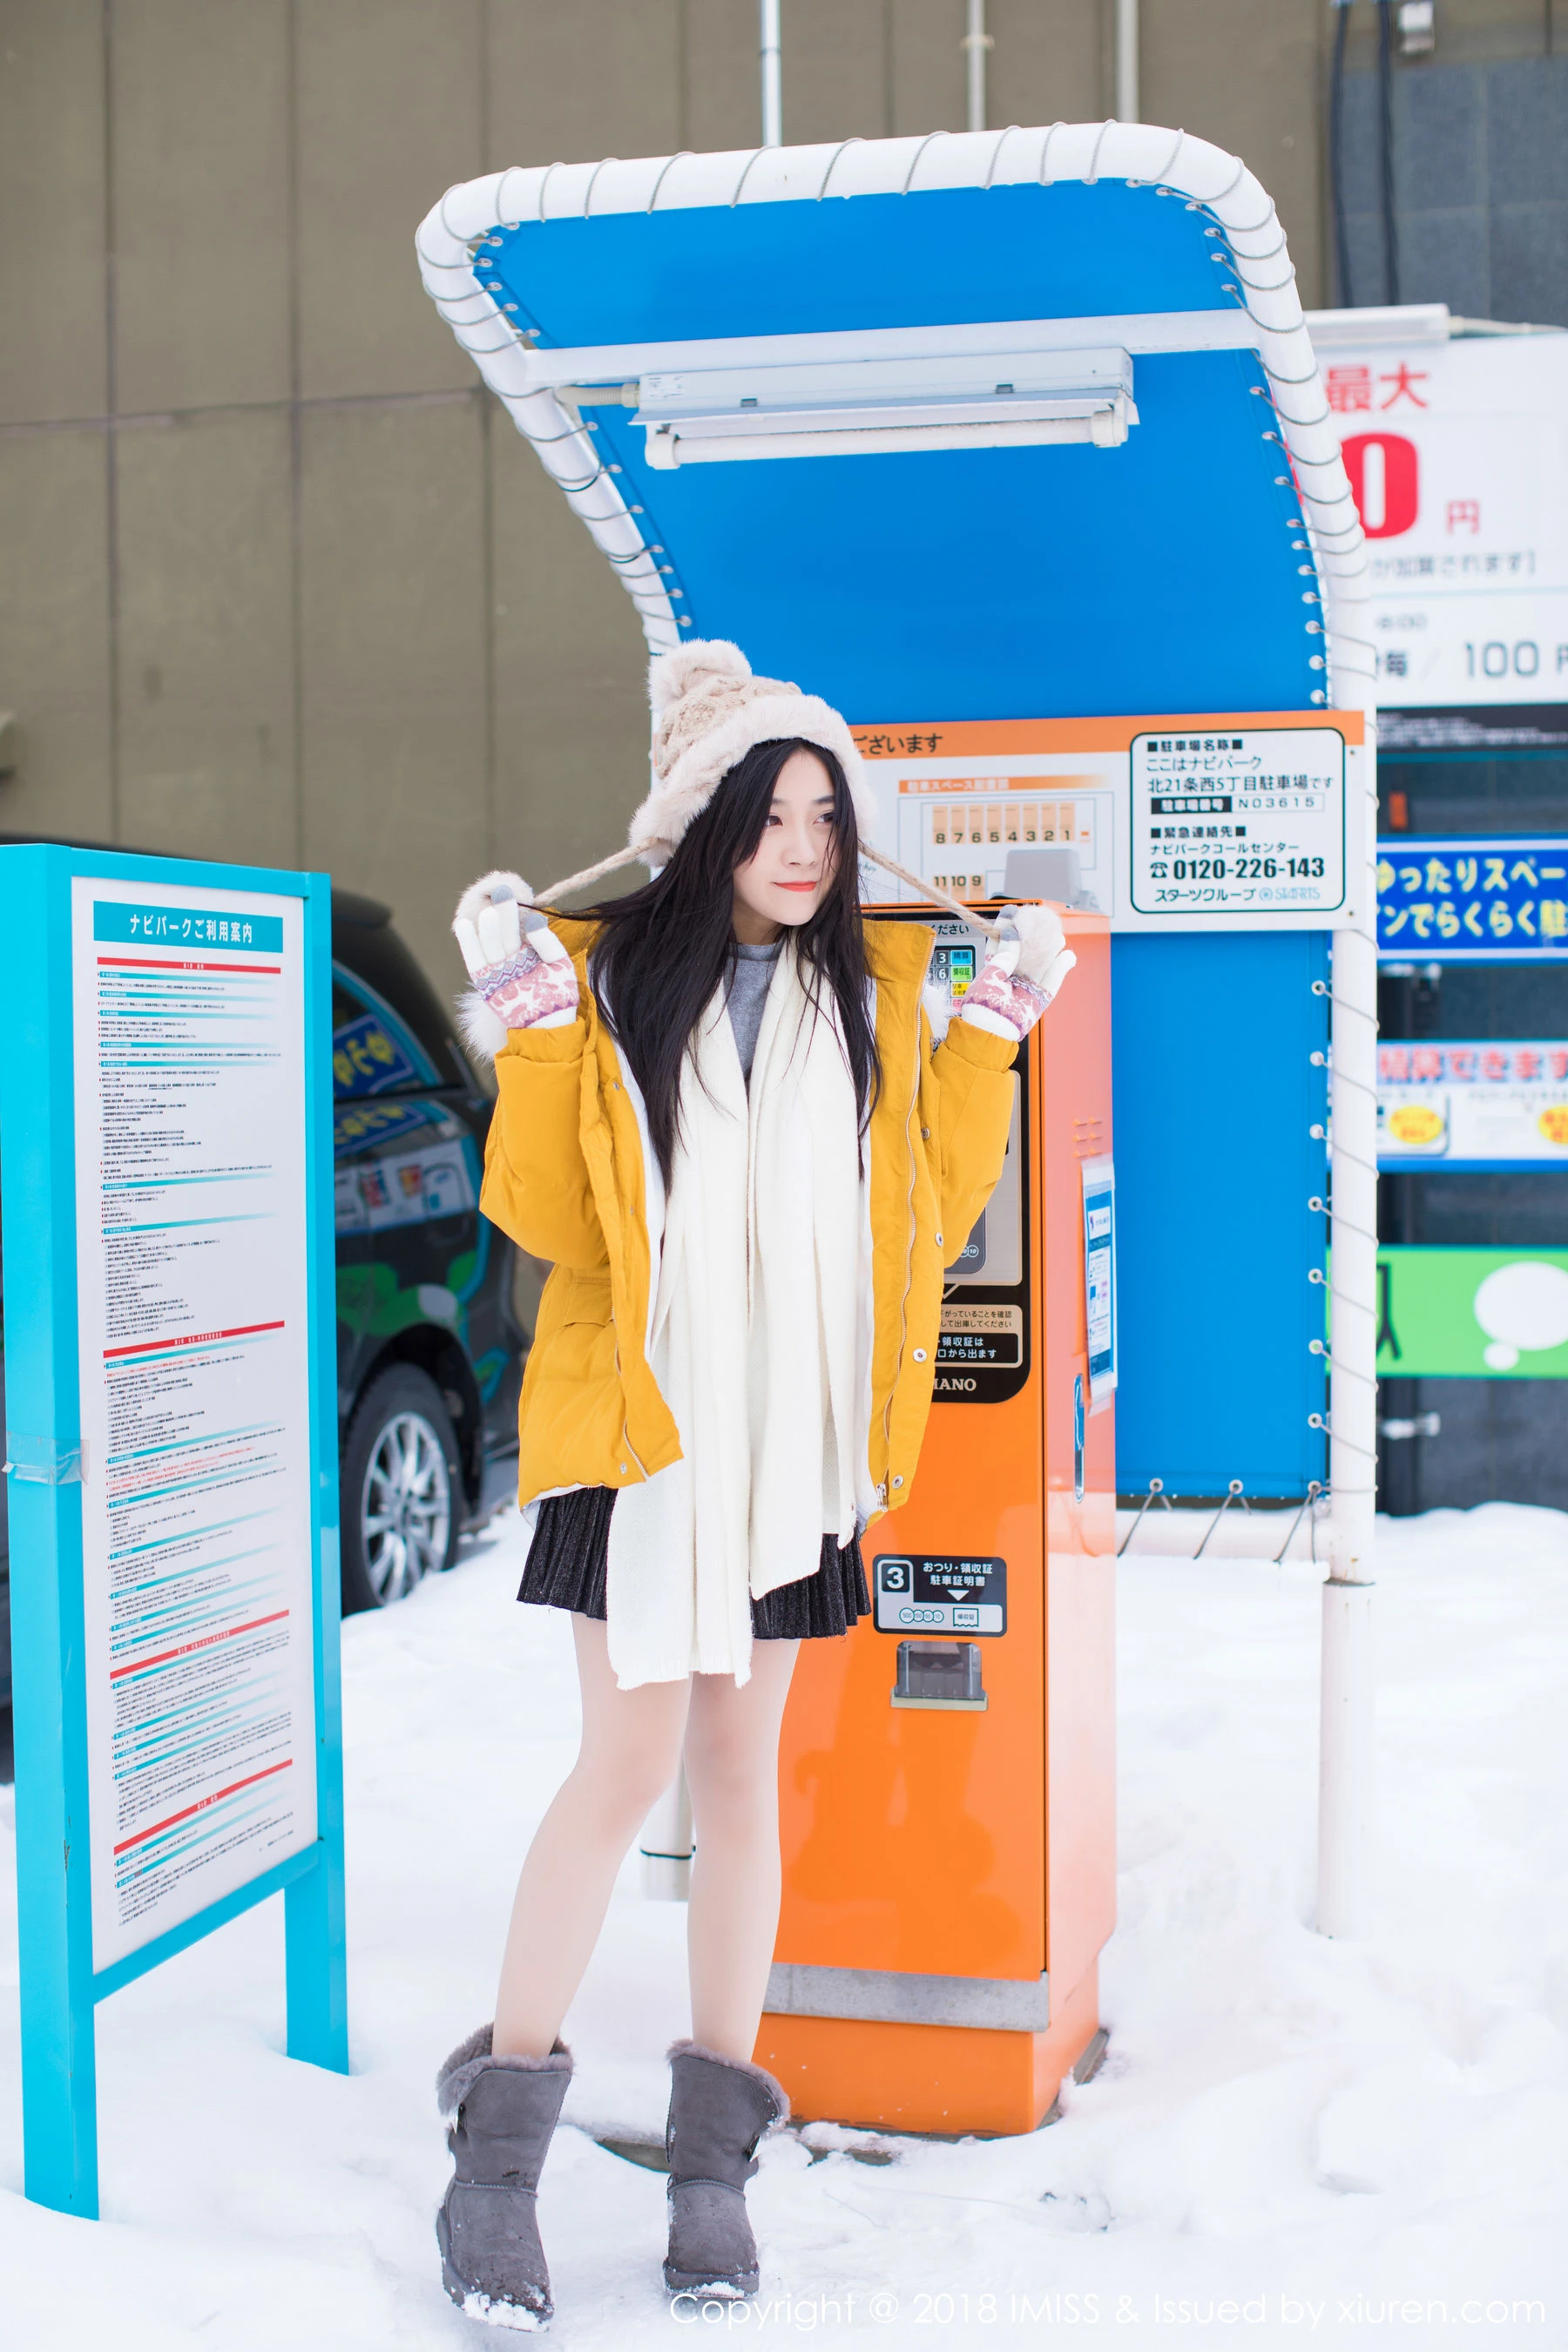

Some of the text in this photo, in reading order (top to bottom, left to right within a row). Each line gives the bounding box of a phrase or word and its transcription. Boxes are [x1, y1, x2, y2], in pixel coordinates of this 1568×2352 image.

[1326, 362, 1428, 414] 最大
[1465, 639, 1540, 678] 100
[1147, 754, 1261, 772] ここはナビパーク
[936, 830, 1071, 844] 8 7 6 5 4 3 2 1
[1150, 842, 1300, 855] ナビパークコールセンター
[1173, 857, 1325, 880] 0120-226-143
[934, 875, 982, 887] 11 10 9
[130, 913, 253, 944] ナビパークご利用案内
[938, 952, 947, 964] 3
[938, 968, 947, 981] 6
[923, 1562, 994, 1574] おつり・領収証
[886, 1566, 905, 1589] 3
[929, 1574, 986, 1587] 駐車証明書
